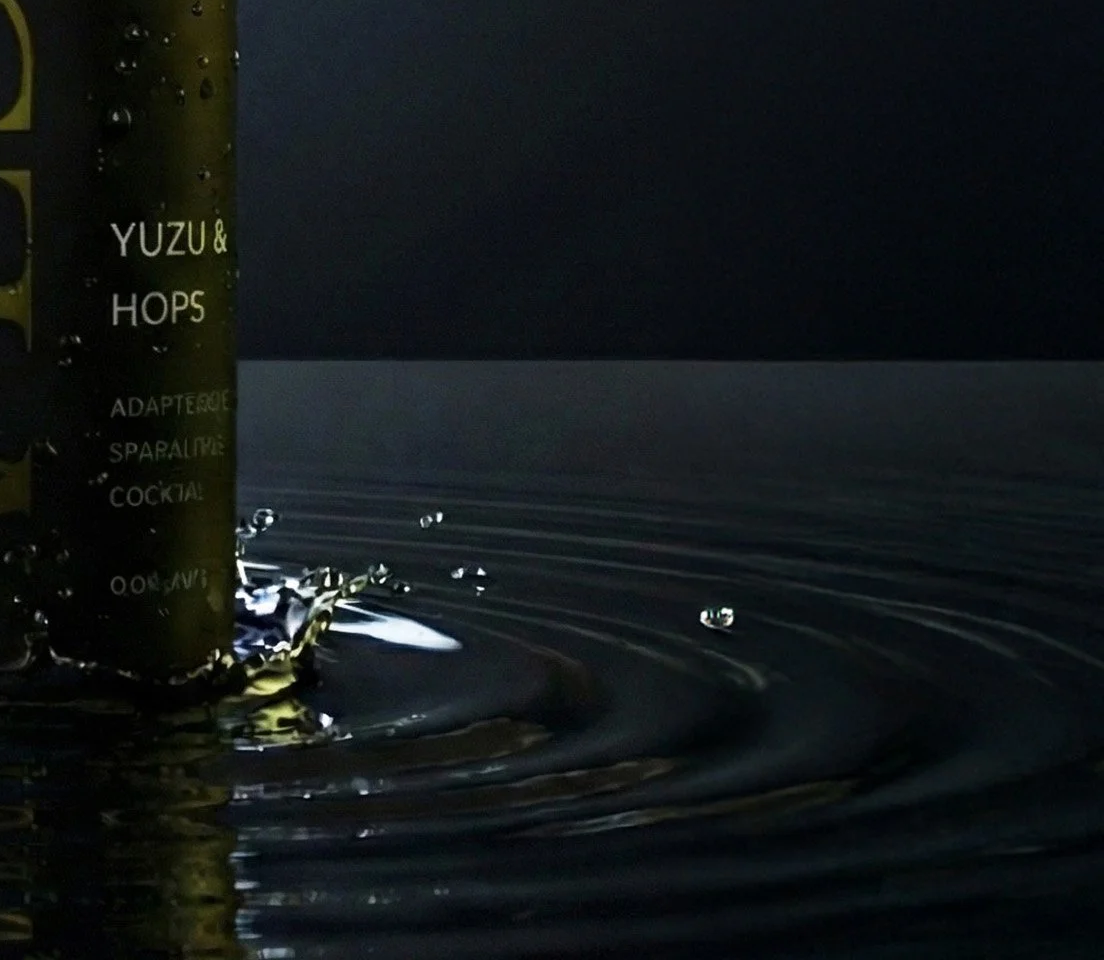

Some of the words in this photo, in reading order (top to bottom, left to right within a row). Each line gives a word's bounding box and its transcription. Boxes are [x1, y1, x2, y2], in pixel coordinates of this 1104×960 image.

[111, 220, 205, 257] YUZU
[213, 218, 227, 254] &
[112, 290, 205, 327] HOPS
